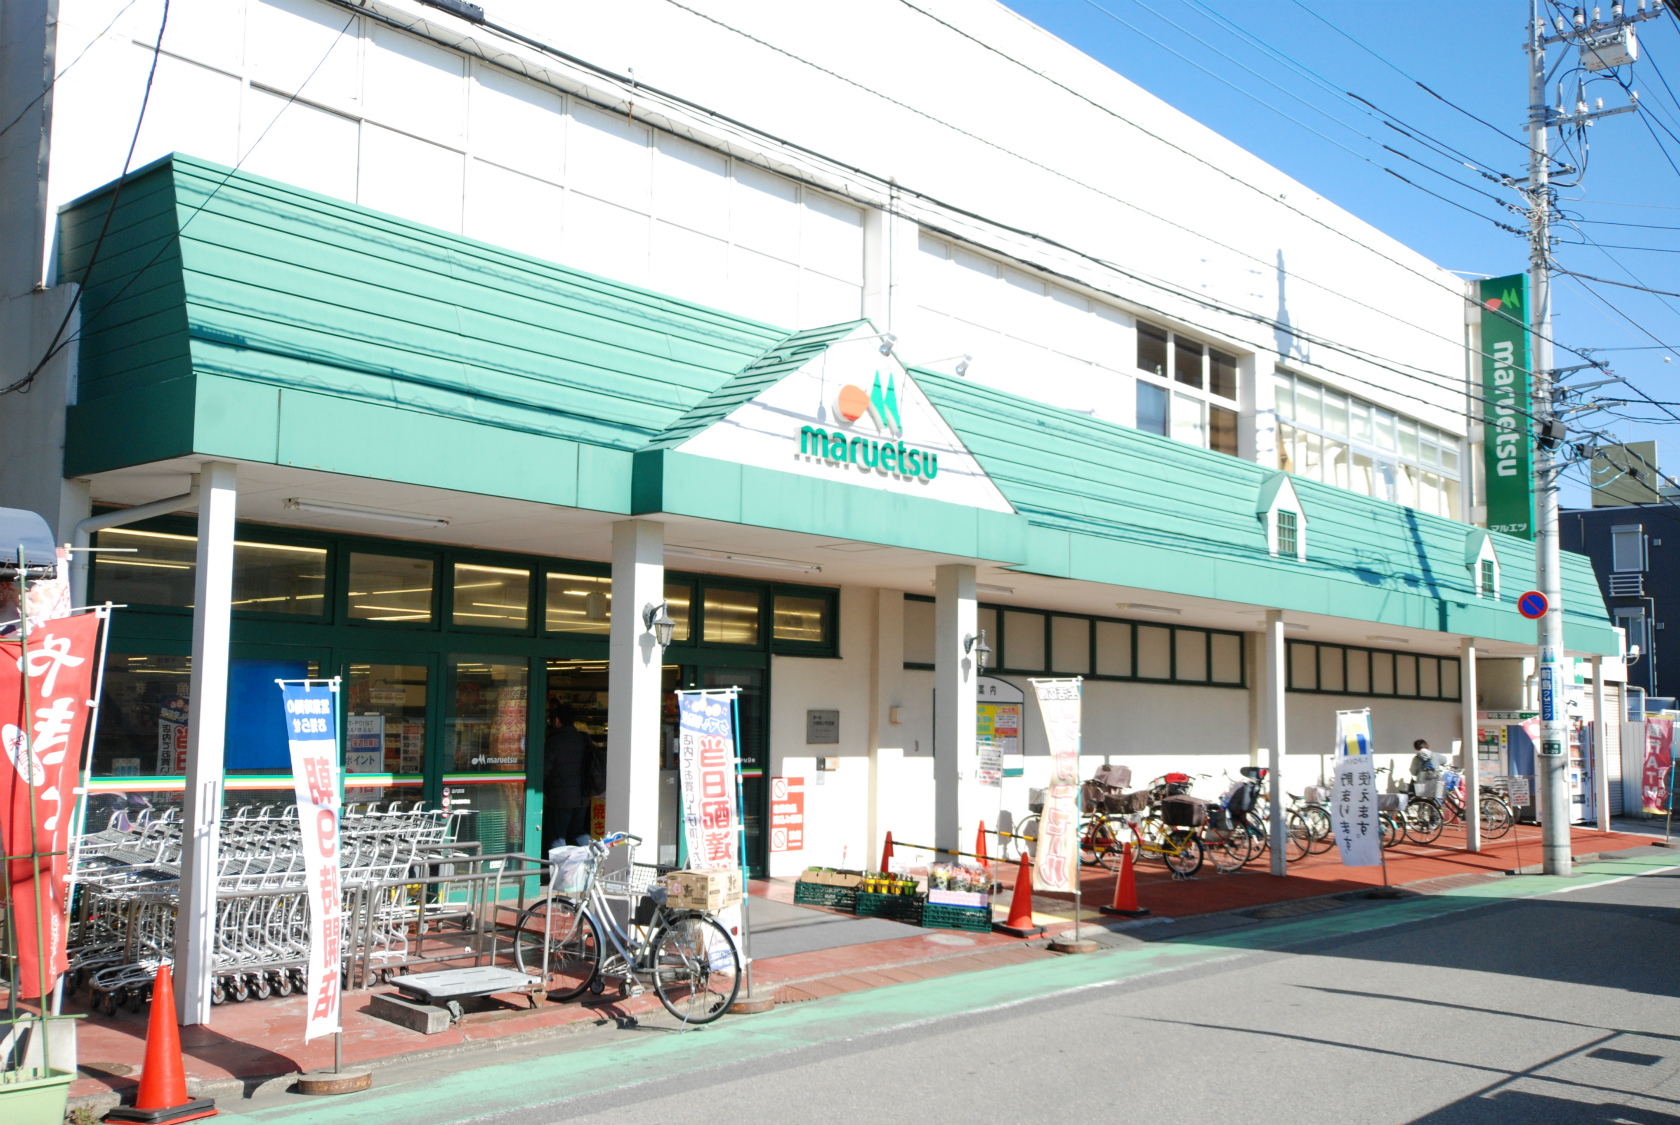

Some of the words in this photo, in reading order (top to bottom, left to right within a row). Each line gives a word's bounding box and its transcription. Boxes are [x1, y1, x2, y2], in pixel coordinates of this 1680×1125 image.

[1493, 340, 1518, 477] maruetsu
[800, 424, 938, 481] maruetsu
[1490, 523, 1527, 533] マルエツ
[346, 754, 375, 766] ポイント
[486, 756, 518, 764] maruetsu
